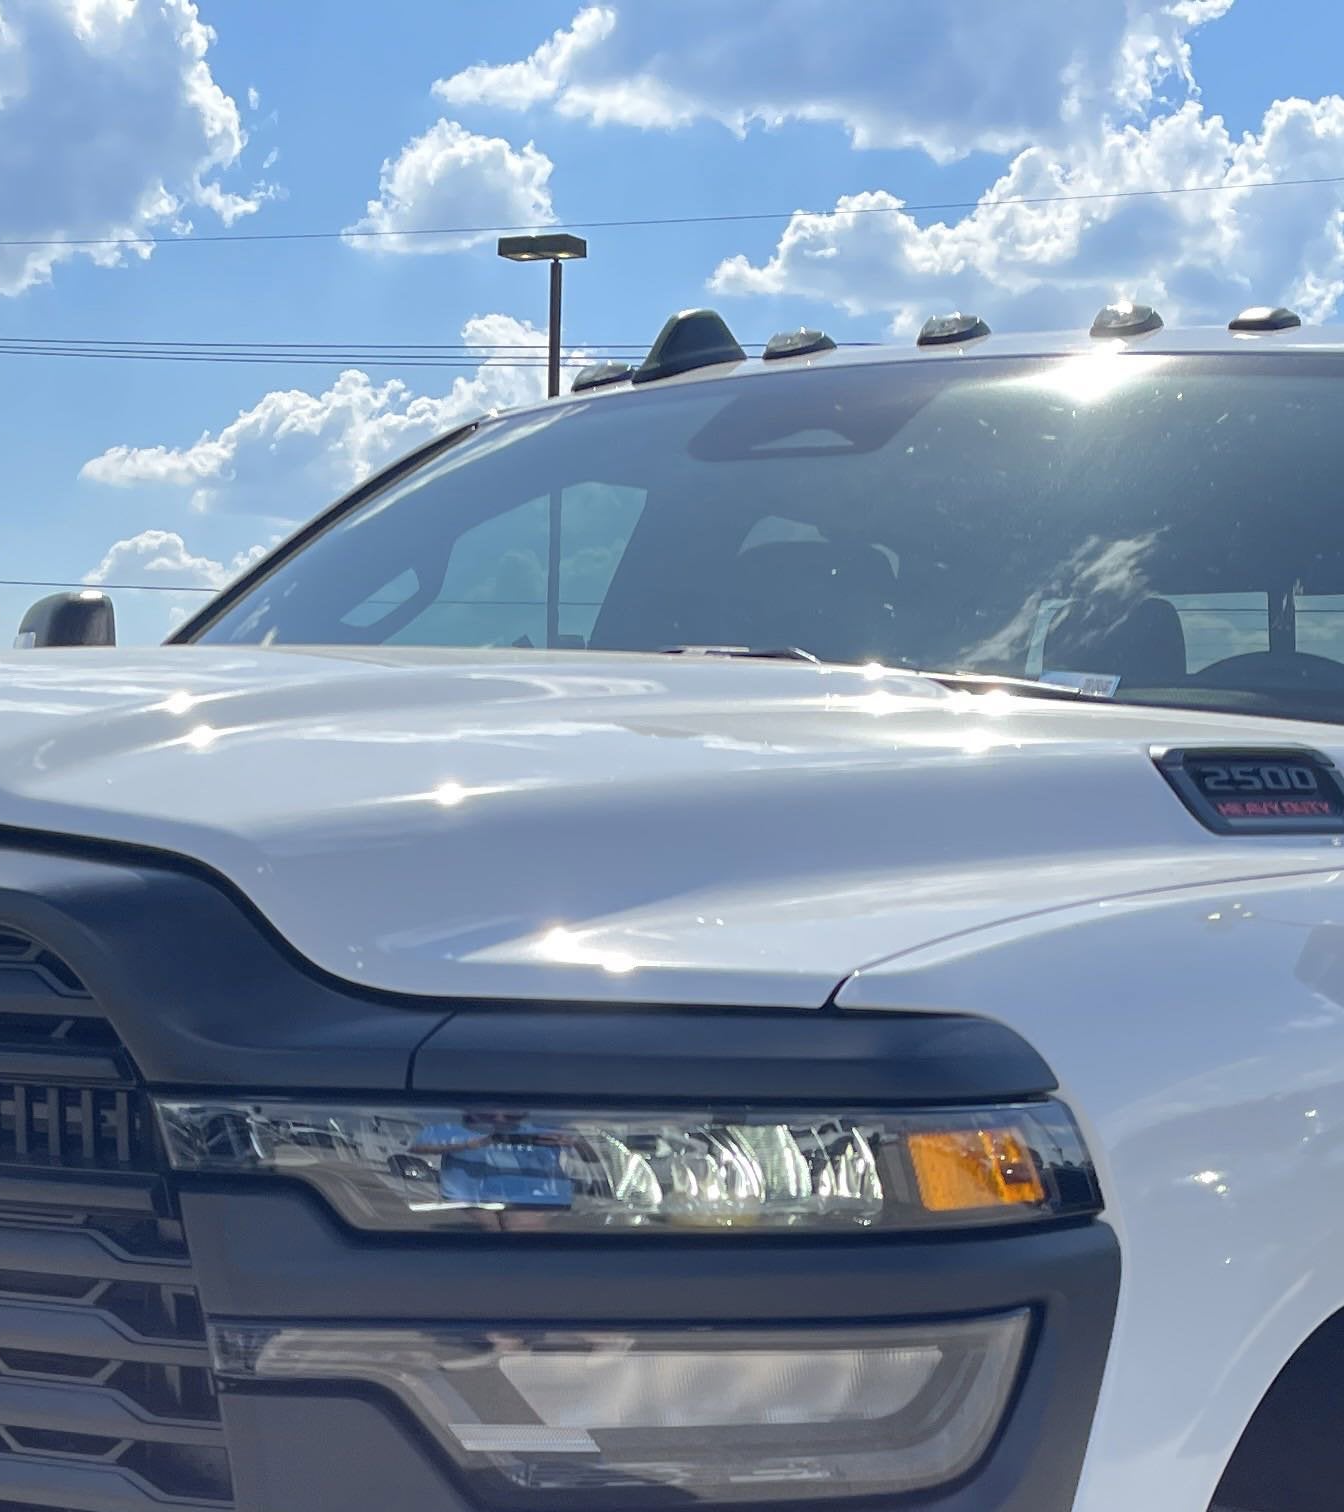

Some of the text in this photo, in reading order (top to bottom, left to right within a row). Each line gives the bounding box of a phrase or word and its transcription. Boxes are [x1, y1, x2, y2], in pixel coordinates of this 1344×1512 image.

[1201, 767, 1317, 790] 2500
[1217, 802, 1329, 815] HEAVY DUTY
